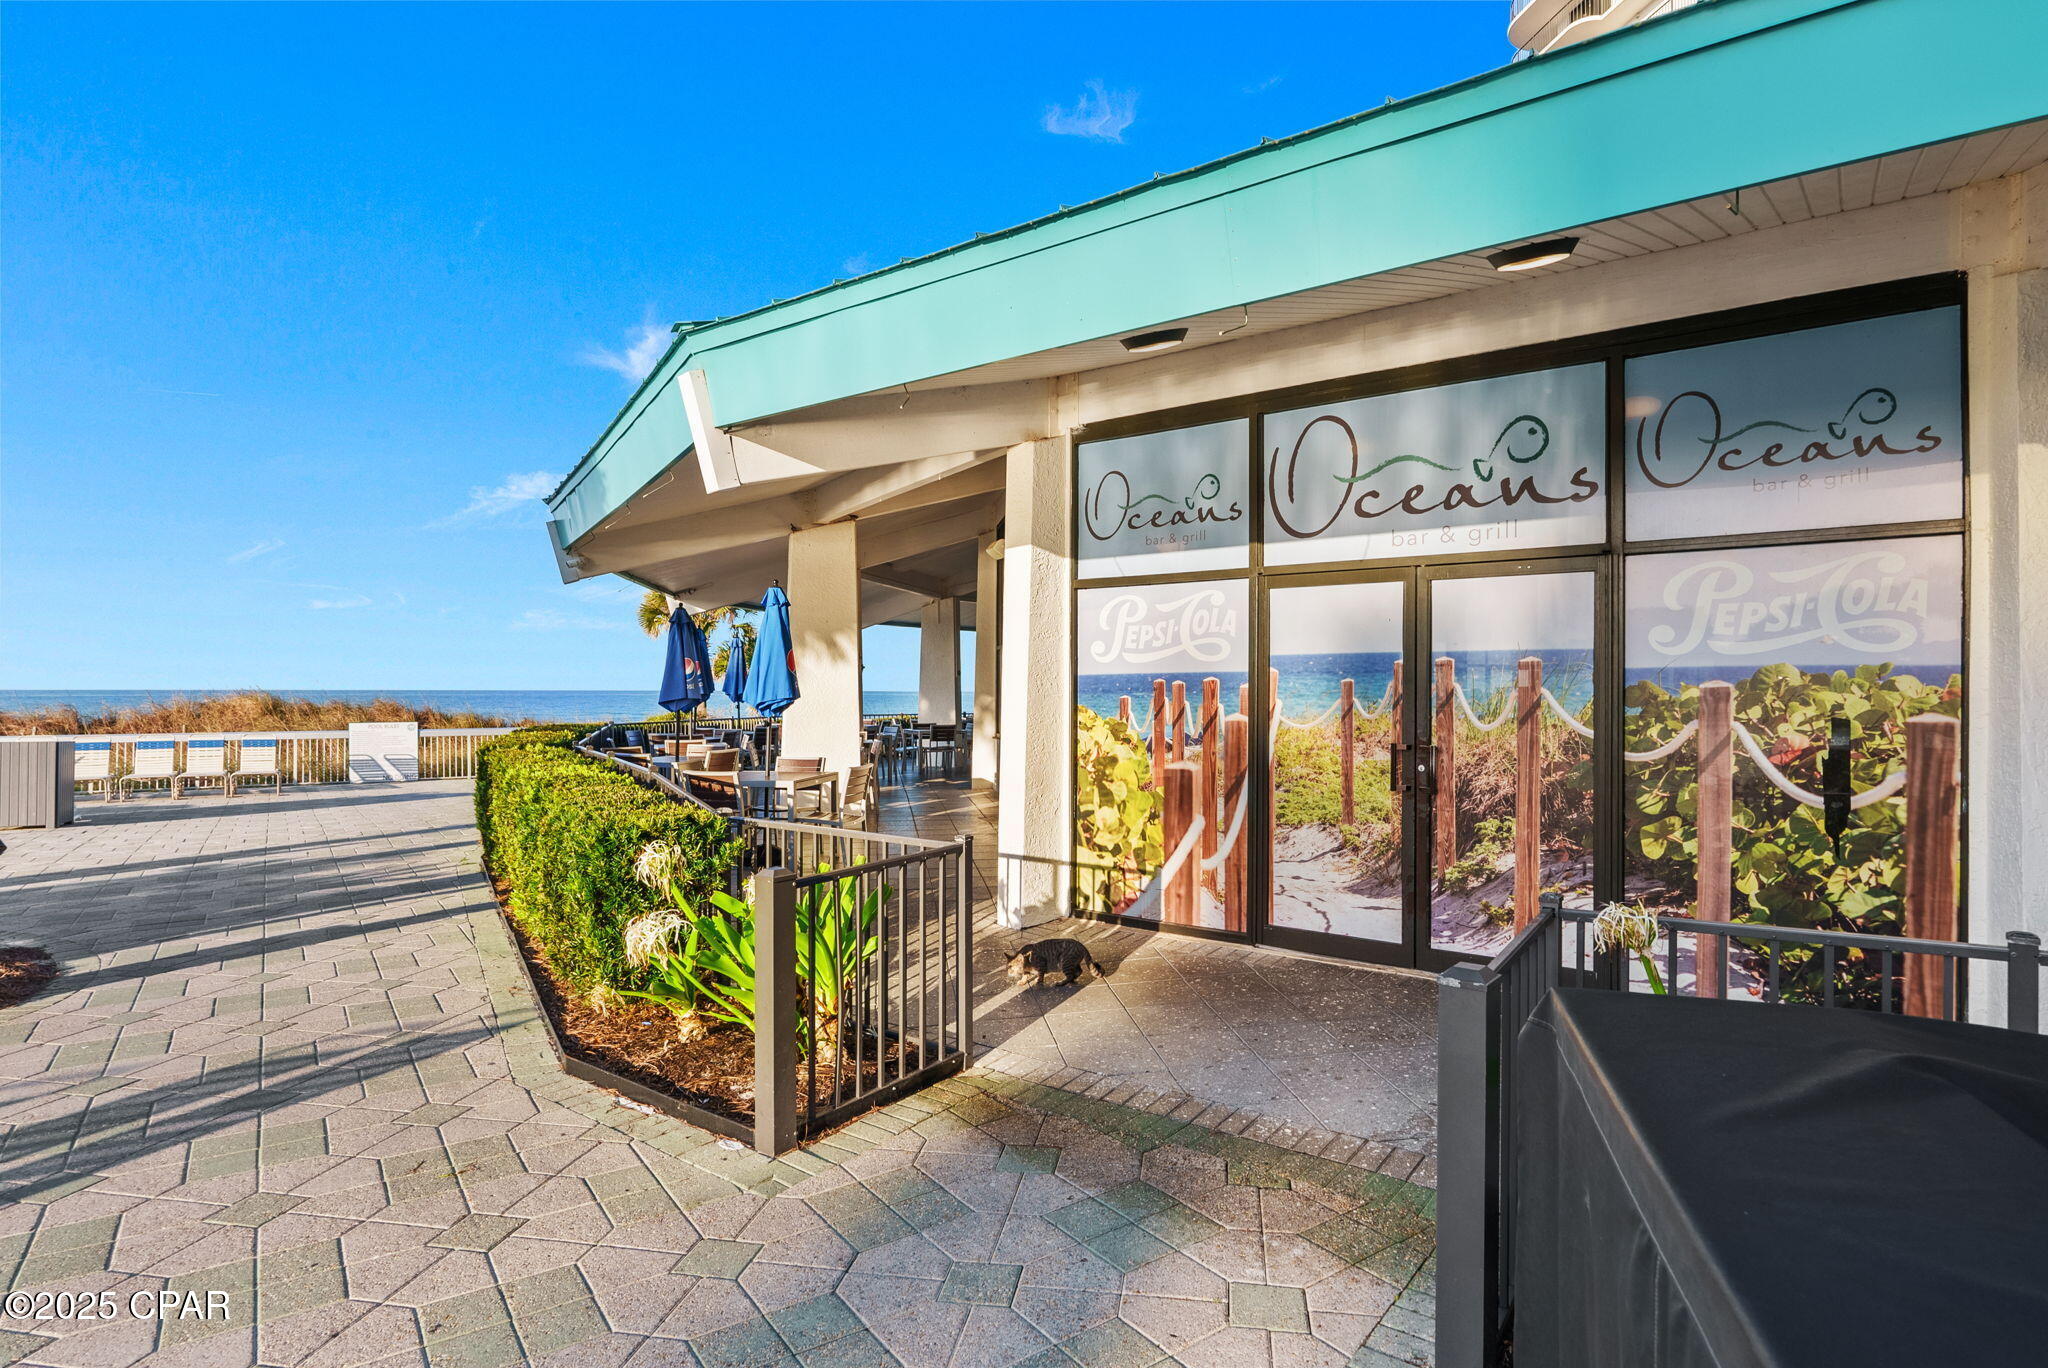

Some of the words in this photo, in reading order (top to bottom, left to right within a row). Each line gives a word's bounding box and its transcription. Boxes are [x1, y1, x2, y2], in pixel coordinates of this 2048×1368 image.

[1637, 388, 1943, 488] Oceans
[1085, 471, 1242, 540] Oceans
[1269, 415, 1599, 538] Oceans
[1753, 478, 1787, 492] bar
[1798, 474, 1812, 488] &
[1824, 467, 1869, 489] grill
[1145, 535, 1164, 546] bar
[1169, 533, 1177, 543] &
[1182, 530, 1207, 545] grill
[1392, 529, 1428, 547] bar
[1440, 525, 1455, 543] &
[1468, 519, 1518, 546] grill
[1091, 590, 1236, 663] PEPSI-COLA
[1649, 552, 1930, 655] PEPSI-COLA
